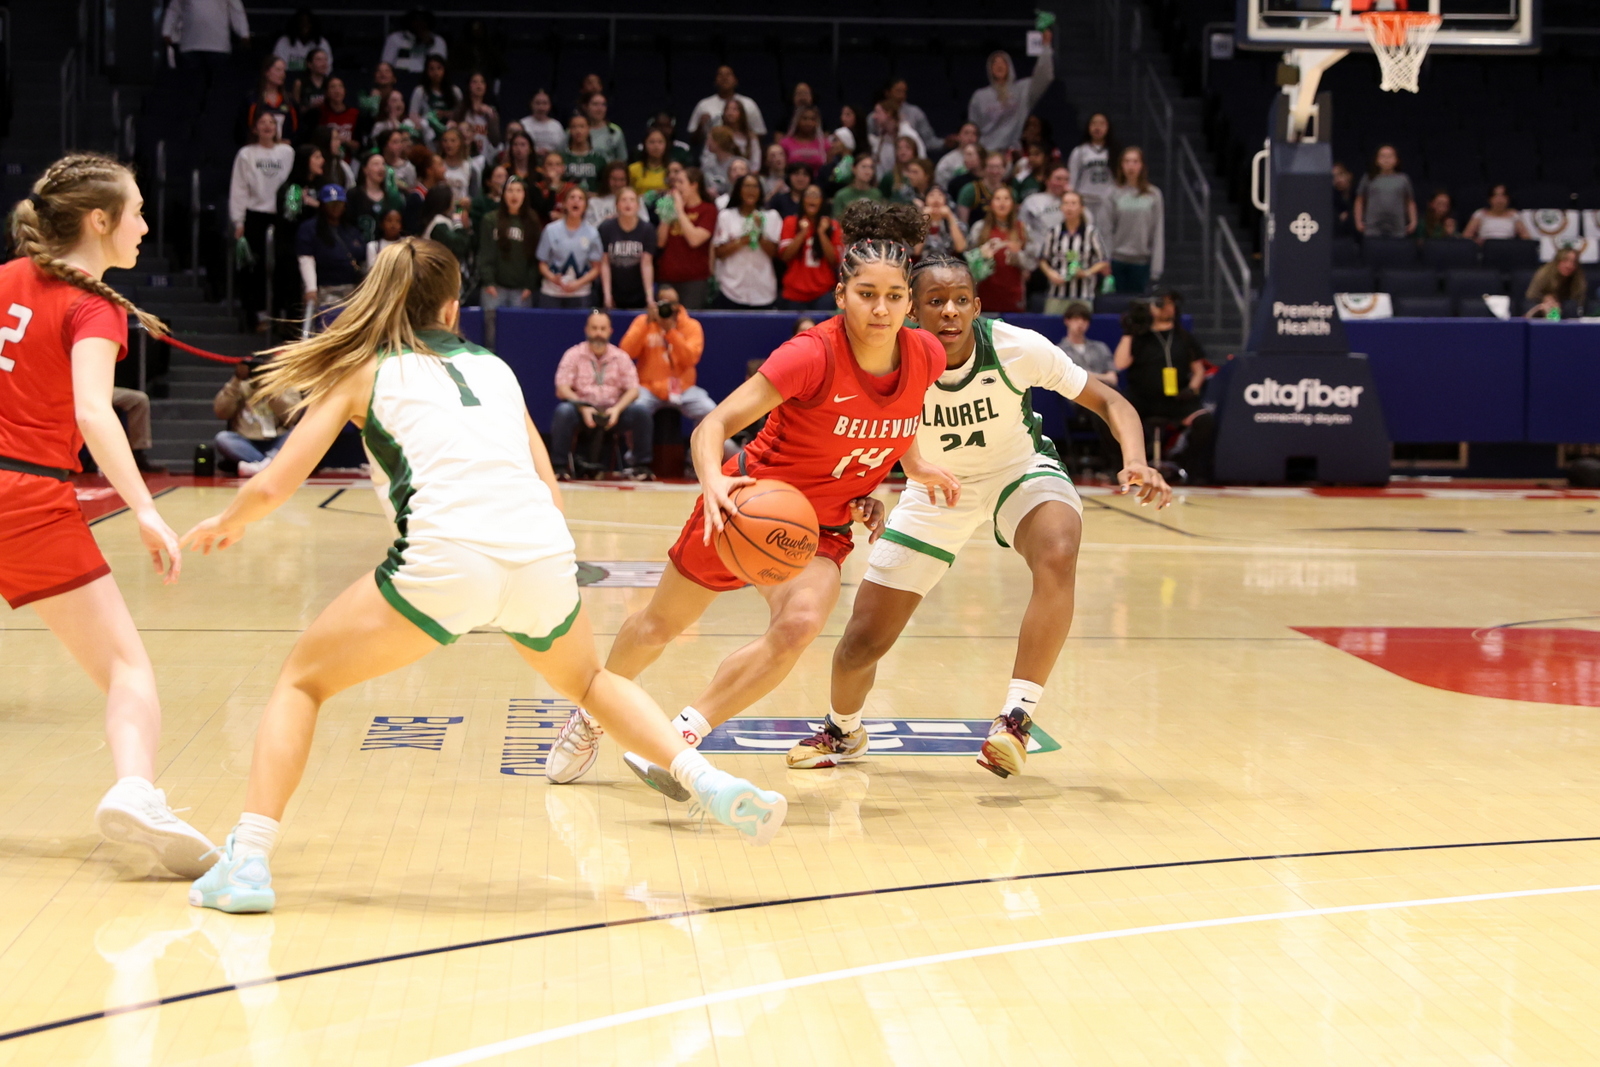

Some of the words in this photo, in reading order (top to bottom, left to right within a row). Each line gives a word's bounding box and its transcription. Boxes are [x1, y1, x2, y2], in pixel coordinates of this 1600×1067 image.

[1272, 300, 1335, 319] Premier
[0, 302, 33, 373] 2
[1277, 318, 1331, 336] Health
[440, 362, 481, 406] 1
[1243, 377, 1364, 412] altafiber
[833, 414, 920, 440] BELLEVUE
[922, 397, 999, 427] LAUREL
[1254, 412, 1313, 426] connecting
[1314, 412, 1352, 426] dayton
[940, 430, 987, 452] 24
[831, 447, 894, 480] 14
[765, 527, 817, 560] Rawling
[360, 716, 464, 751] BANK
